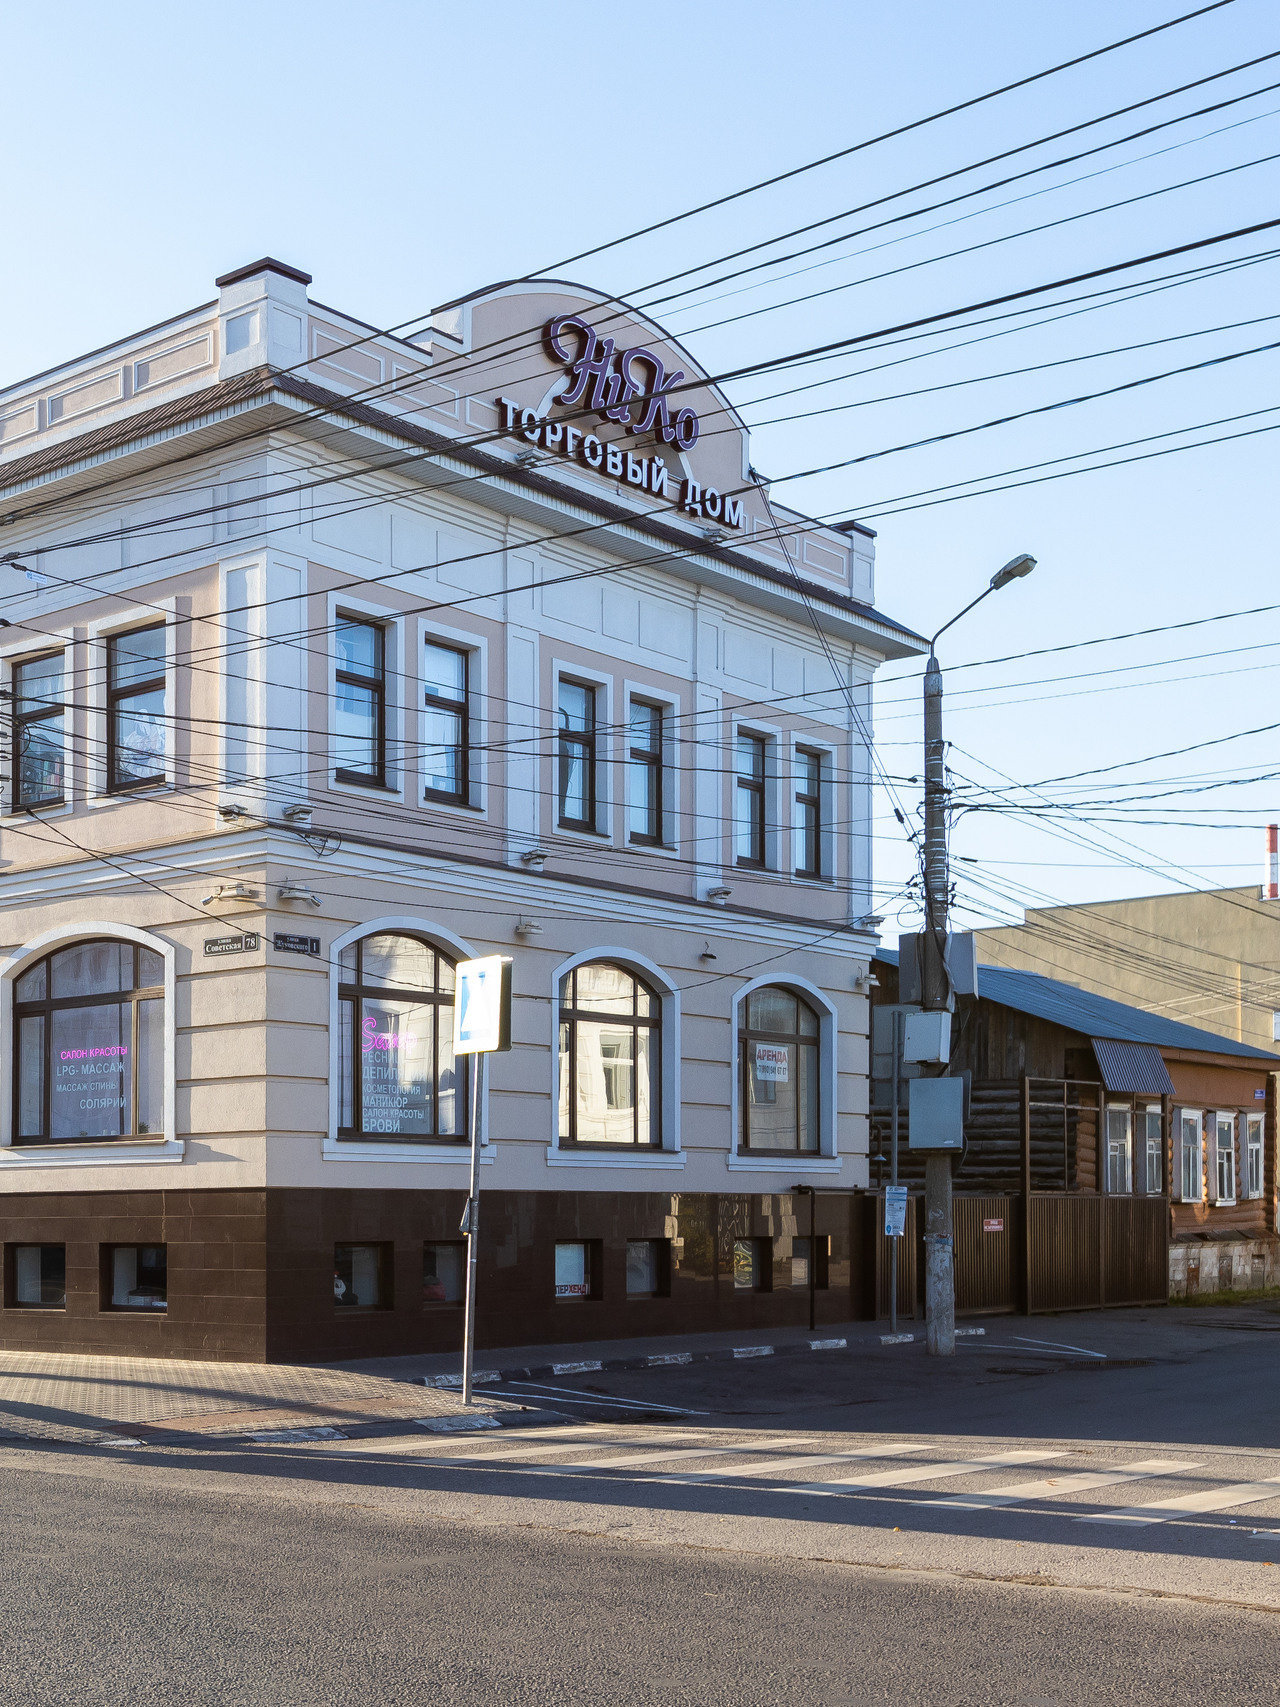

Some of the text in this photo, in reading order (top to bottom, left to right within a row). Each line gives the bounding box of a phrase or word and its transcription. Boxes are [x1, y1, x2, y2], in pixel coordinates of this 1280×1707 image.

[544, 313, 700, 452] НиКо
[498, 396, 744, 529] ТОРГОВЫЙ ДОМ
[206, 937, 256, 953] Советская 78
[60, 1046, 128, 1060] САЛОН КРАСОТЫ
[757, 1048, 787, 1064] АРЕНДА
[81, 1061, 126, 1075] МАССАЖ
[56, 1081, 118, 1092] МАССАЖ СПИНЫ
[362, 1084, 421, 1095] КОСМЕТОЛОГИЯ
[80, 1095, 126, 1109] СОЛЯРИЙ
[362, 1096, 408, 1108] МАНИКЮР
[362, 1108, 424, 1119] САЛОН КРАСОТЫ
[362, 1118, 400, 1132] БРОВИ
